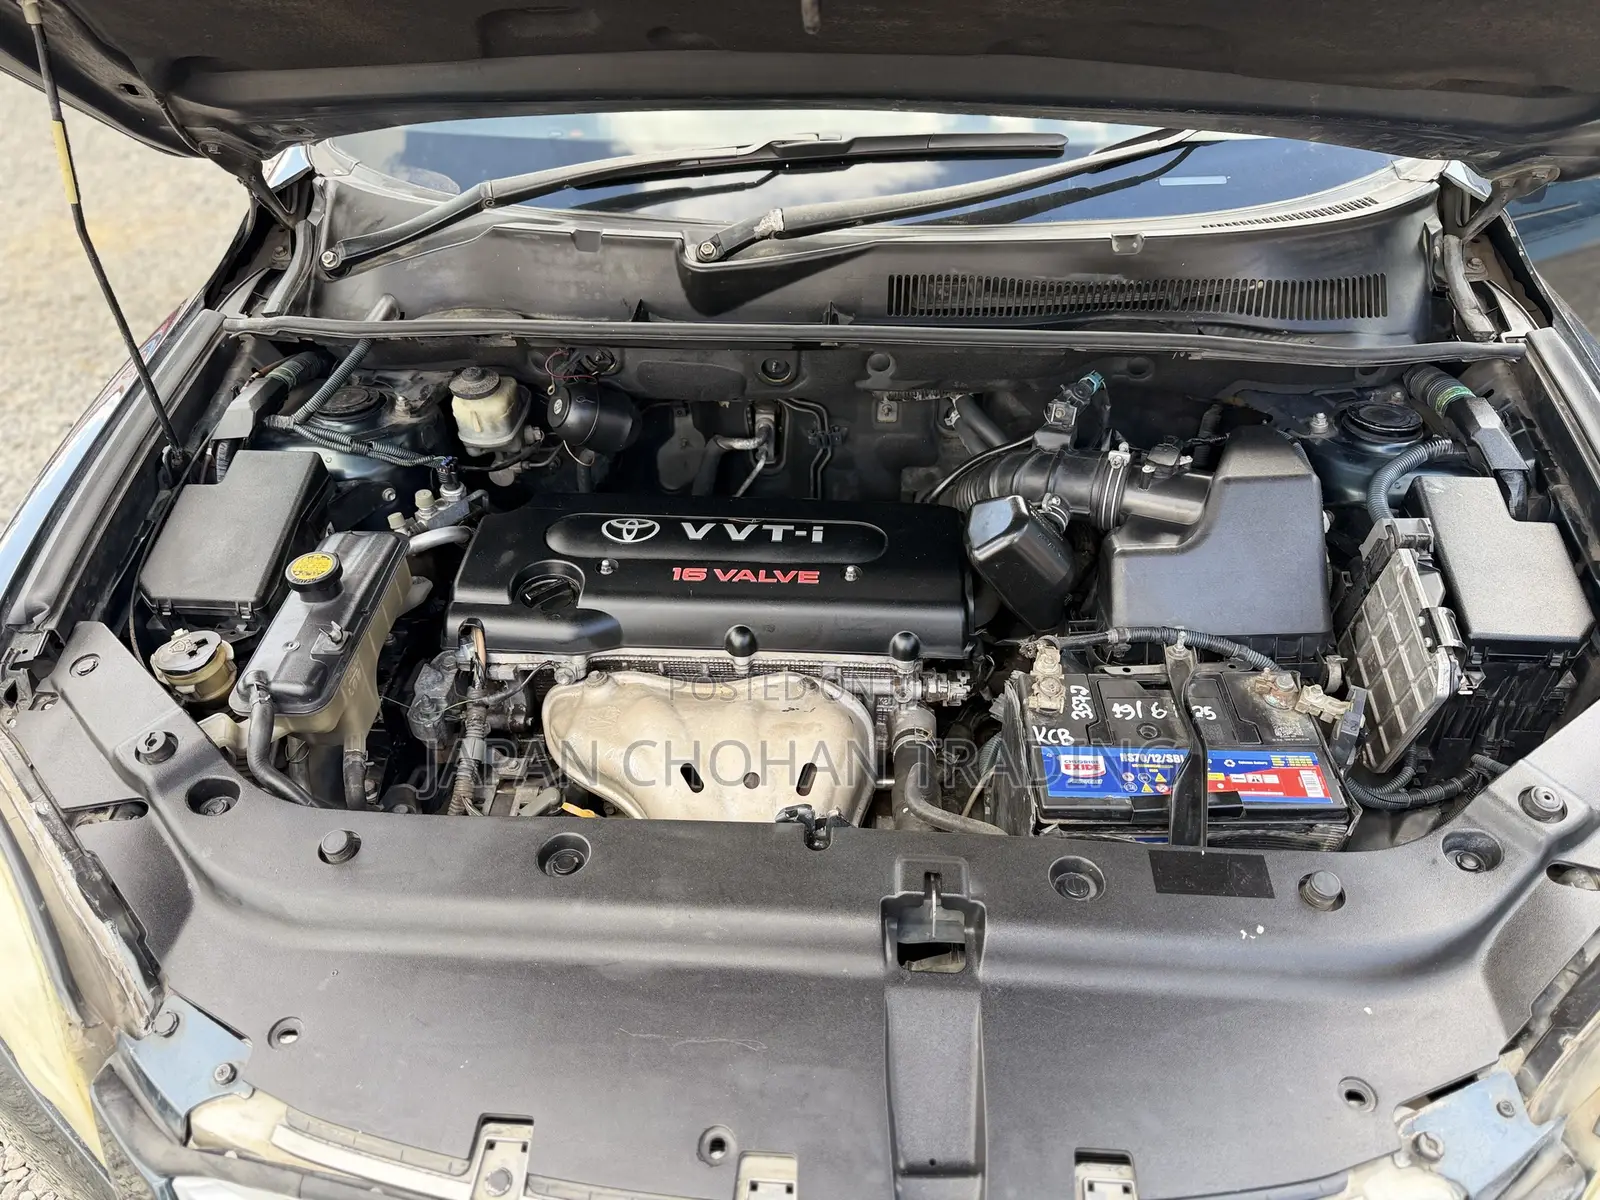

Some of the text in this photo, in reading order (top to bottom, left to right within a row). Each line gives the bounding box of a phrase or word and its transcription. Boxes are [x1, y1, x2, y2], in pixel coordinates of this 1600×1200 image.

[681, 522, 824, 543] VVT-i
[672, 567, 820, 584] 16 VALVE
[1032, 725, 1075, 746] KCB
[1063, 763, 1101, 771] EXIDE
